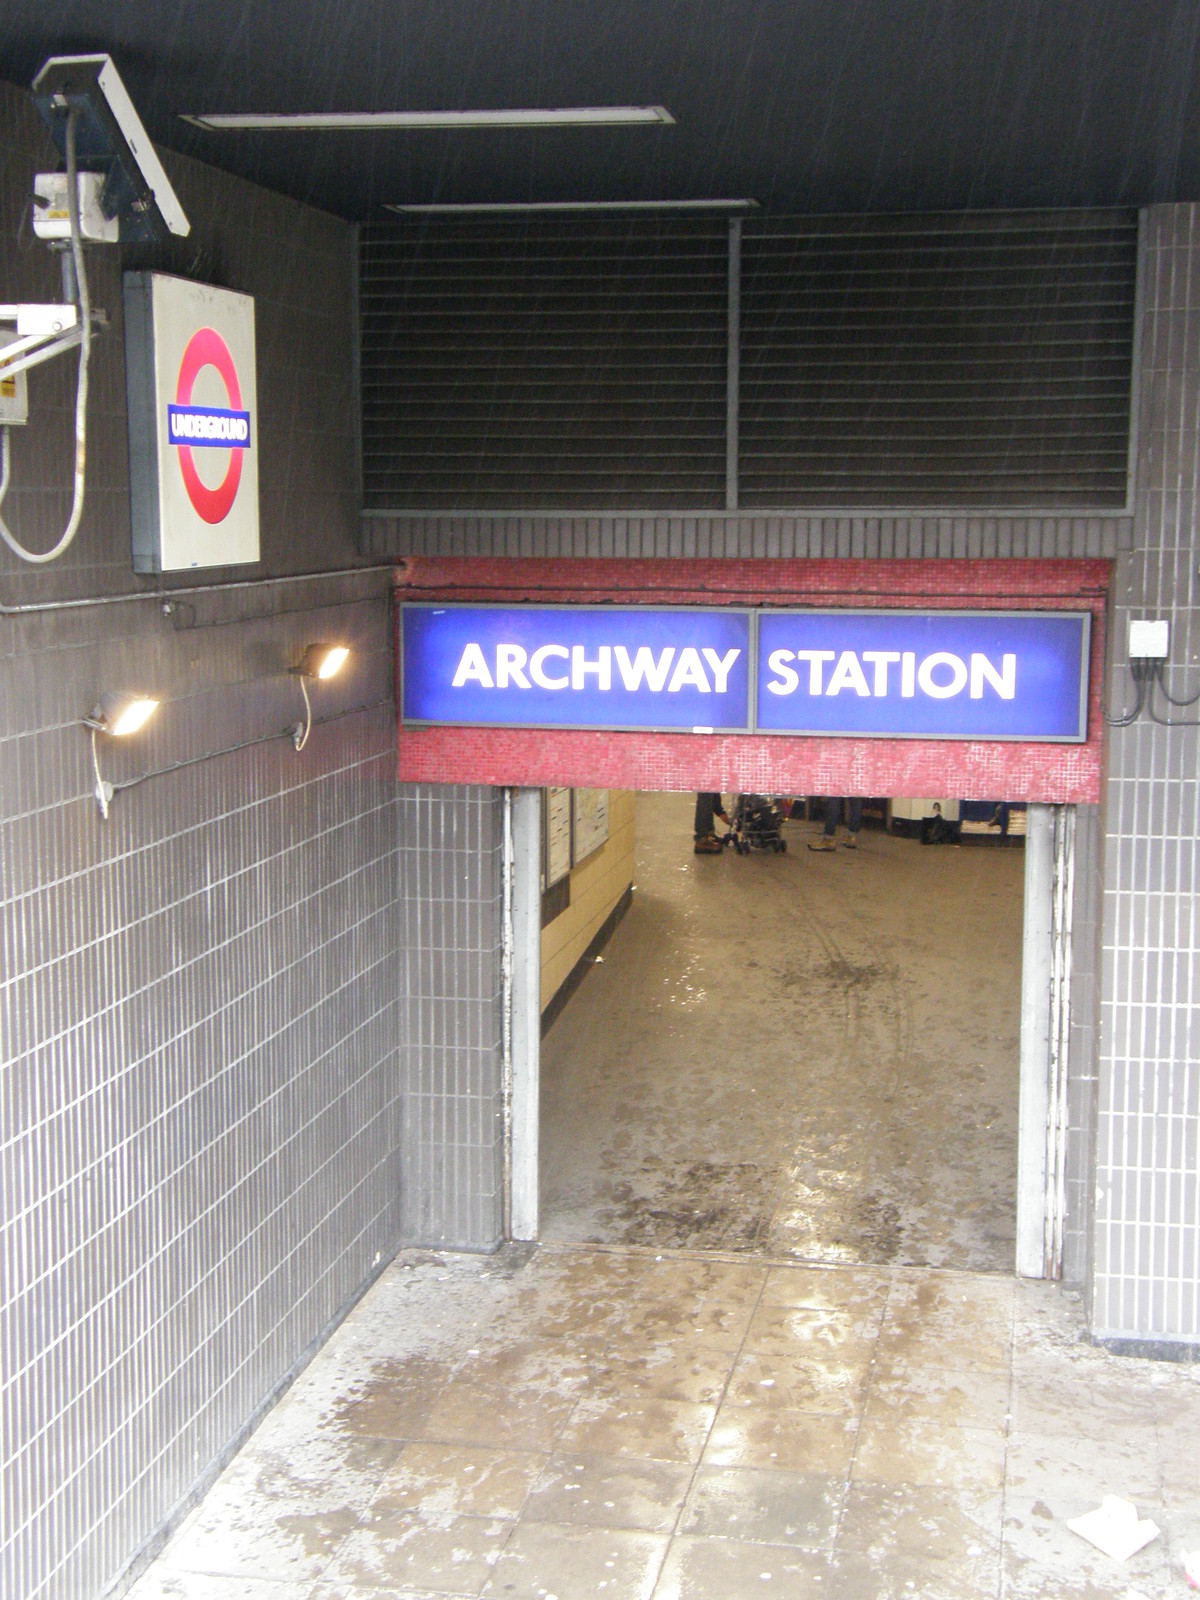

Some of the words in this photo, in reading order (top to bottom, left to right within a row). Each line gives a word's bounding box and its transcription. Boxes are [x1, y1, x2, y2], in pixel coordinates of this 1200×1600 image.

[171, 413, 248, 440] UNDERGROUND
[451, 643, 742, 694] ARCHWAY
[766, 648, 1017, 700] STATION
